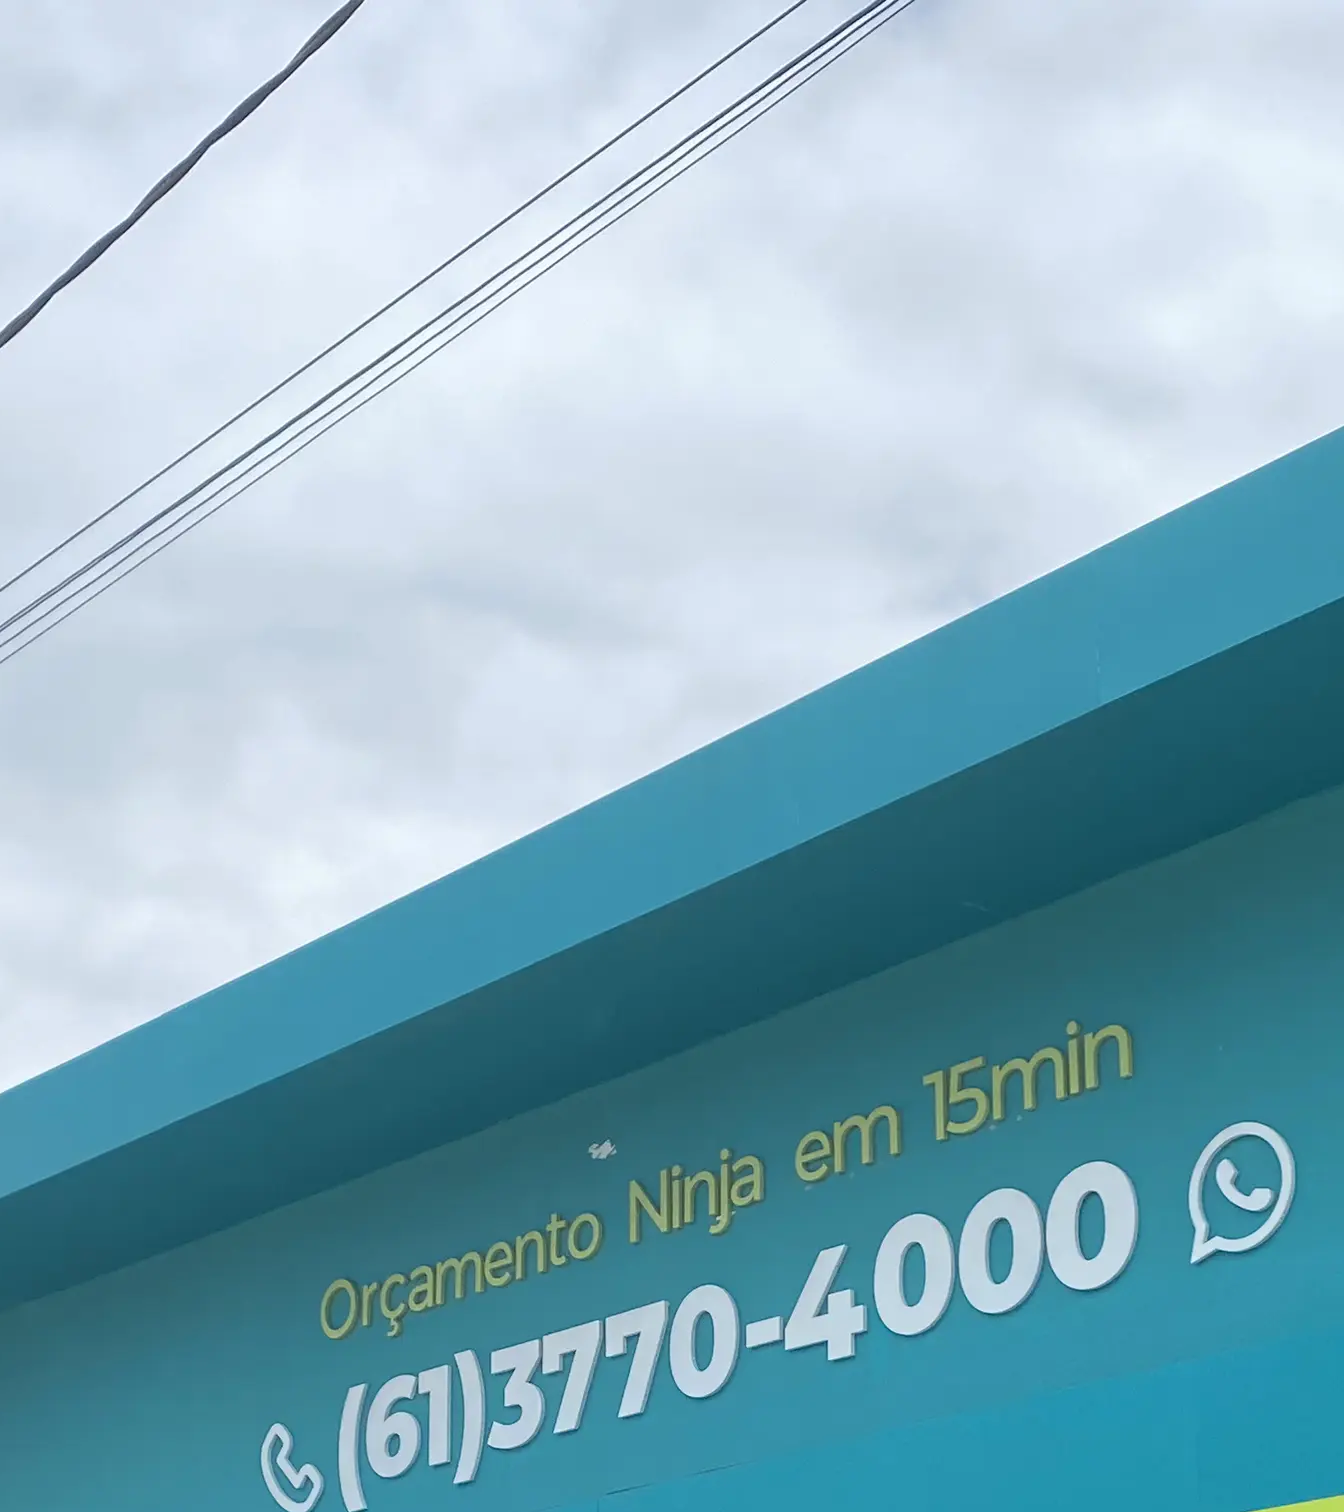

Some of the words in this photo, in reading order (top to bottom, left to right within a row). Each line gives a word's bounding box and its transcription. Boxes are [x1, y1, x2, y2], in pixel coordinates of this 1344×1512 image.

[319, 1206, 602, 1340] Orçamento
[627, 1148, 765, 1244] Ninja
[794, 1101, 902, 1185] em
[922, 1020, 1134, 1143] 15min
[337, 1160, 1140, 1512] (61)3770-4000
